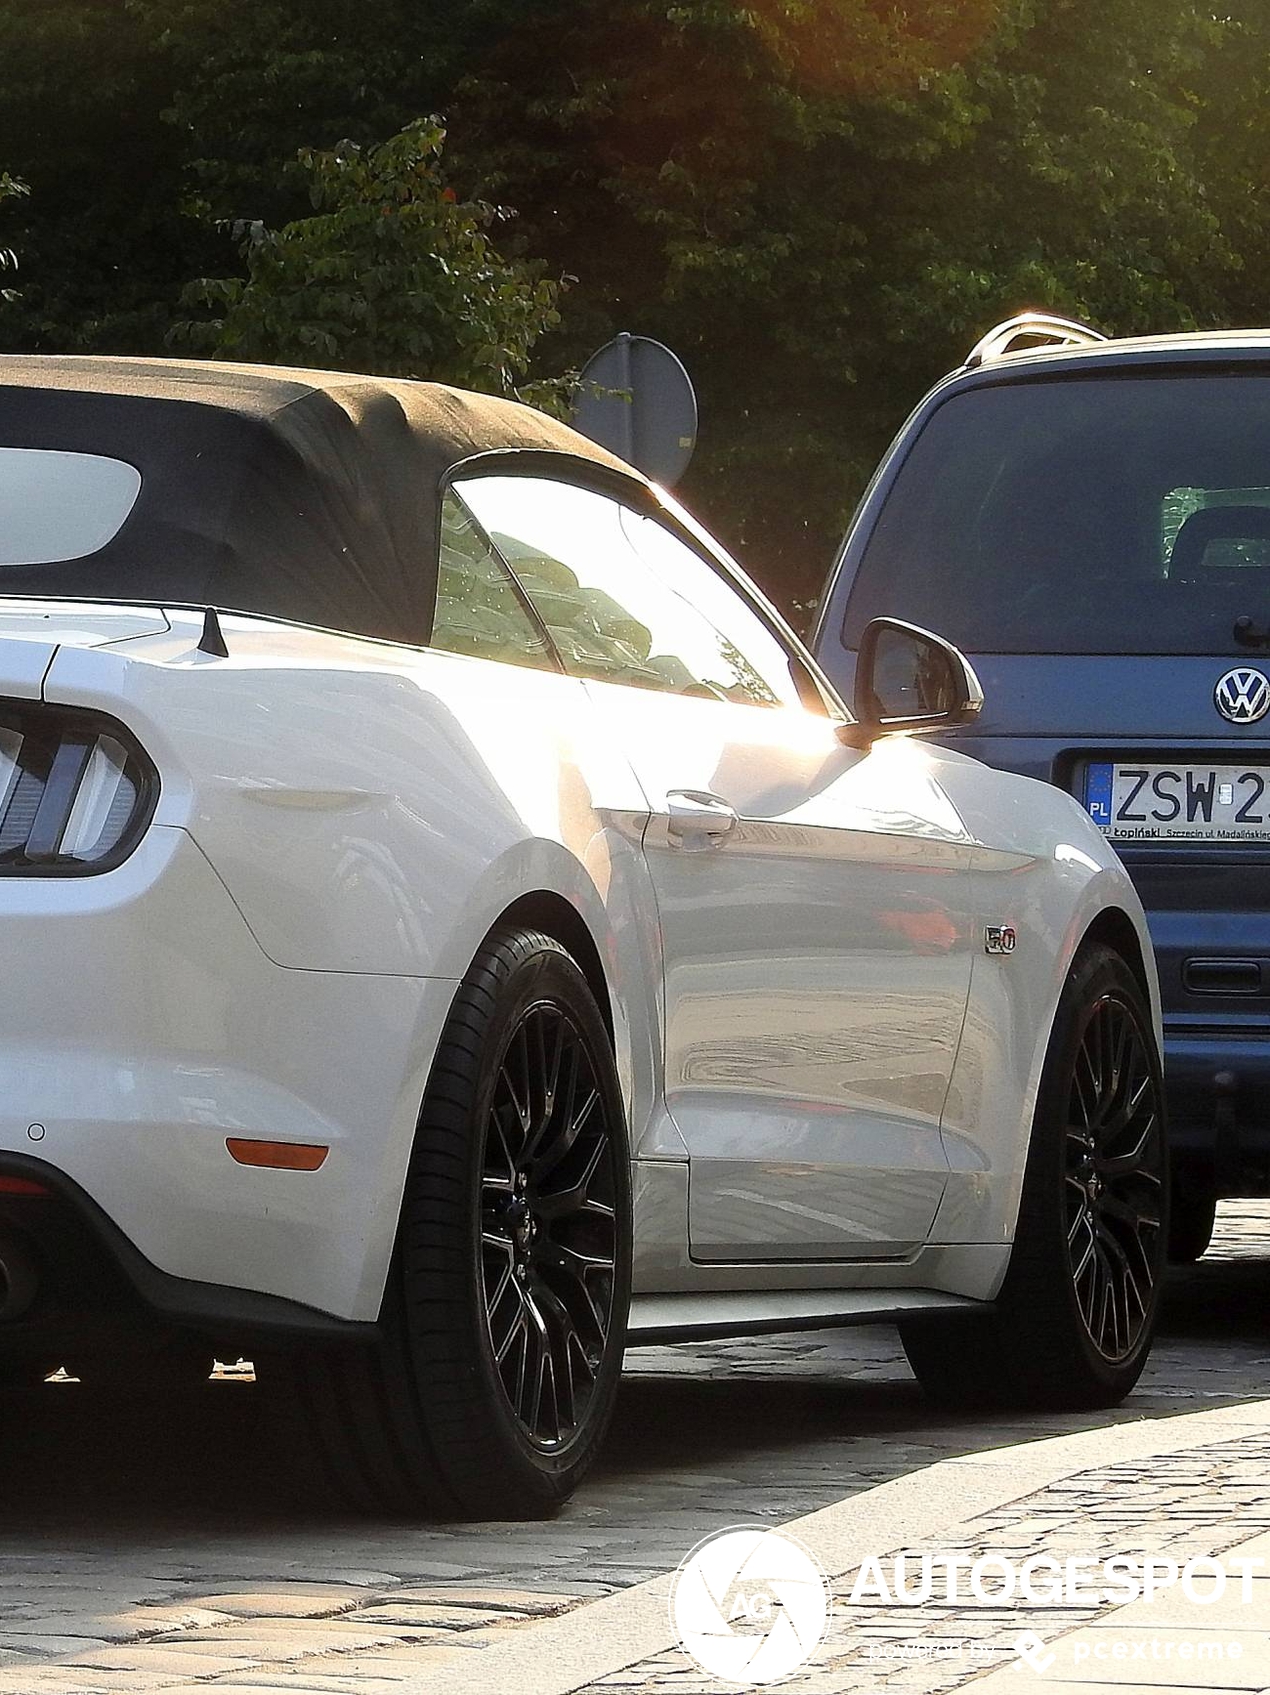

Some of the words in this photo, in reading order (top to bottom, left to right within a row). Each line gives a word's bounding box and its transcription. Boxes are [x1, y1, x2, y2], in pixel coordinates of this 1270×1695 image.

[1090, 803, 1108, 816] PL
[1116, 771, 1216, 822] ZSW
[1235, 772, 1270, 823] 2
